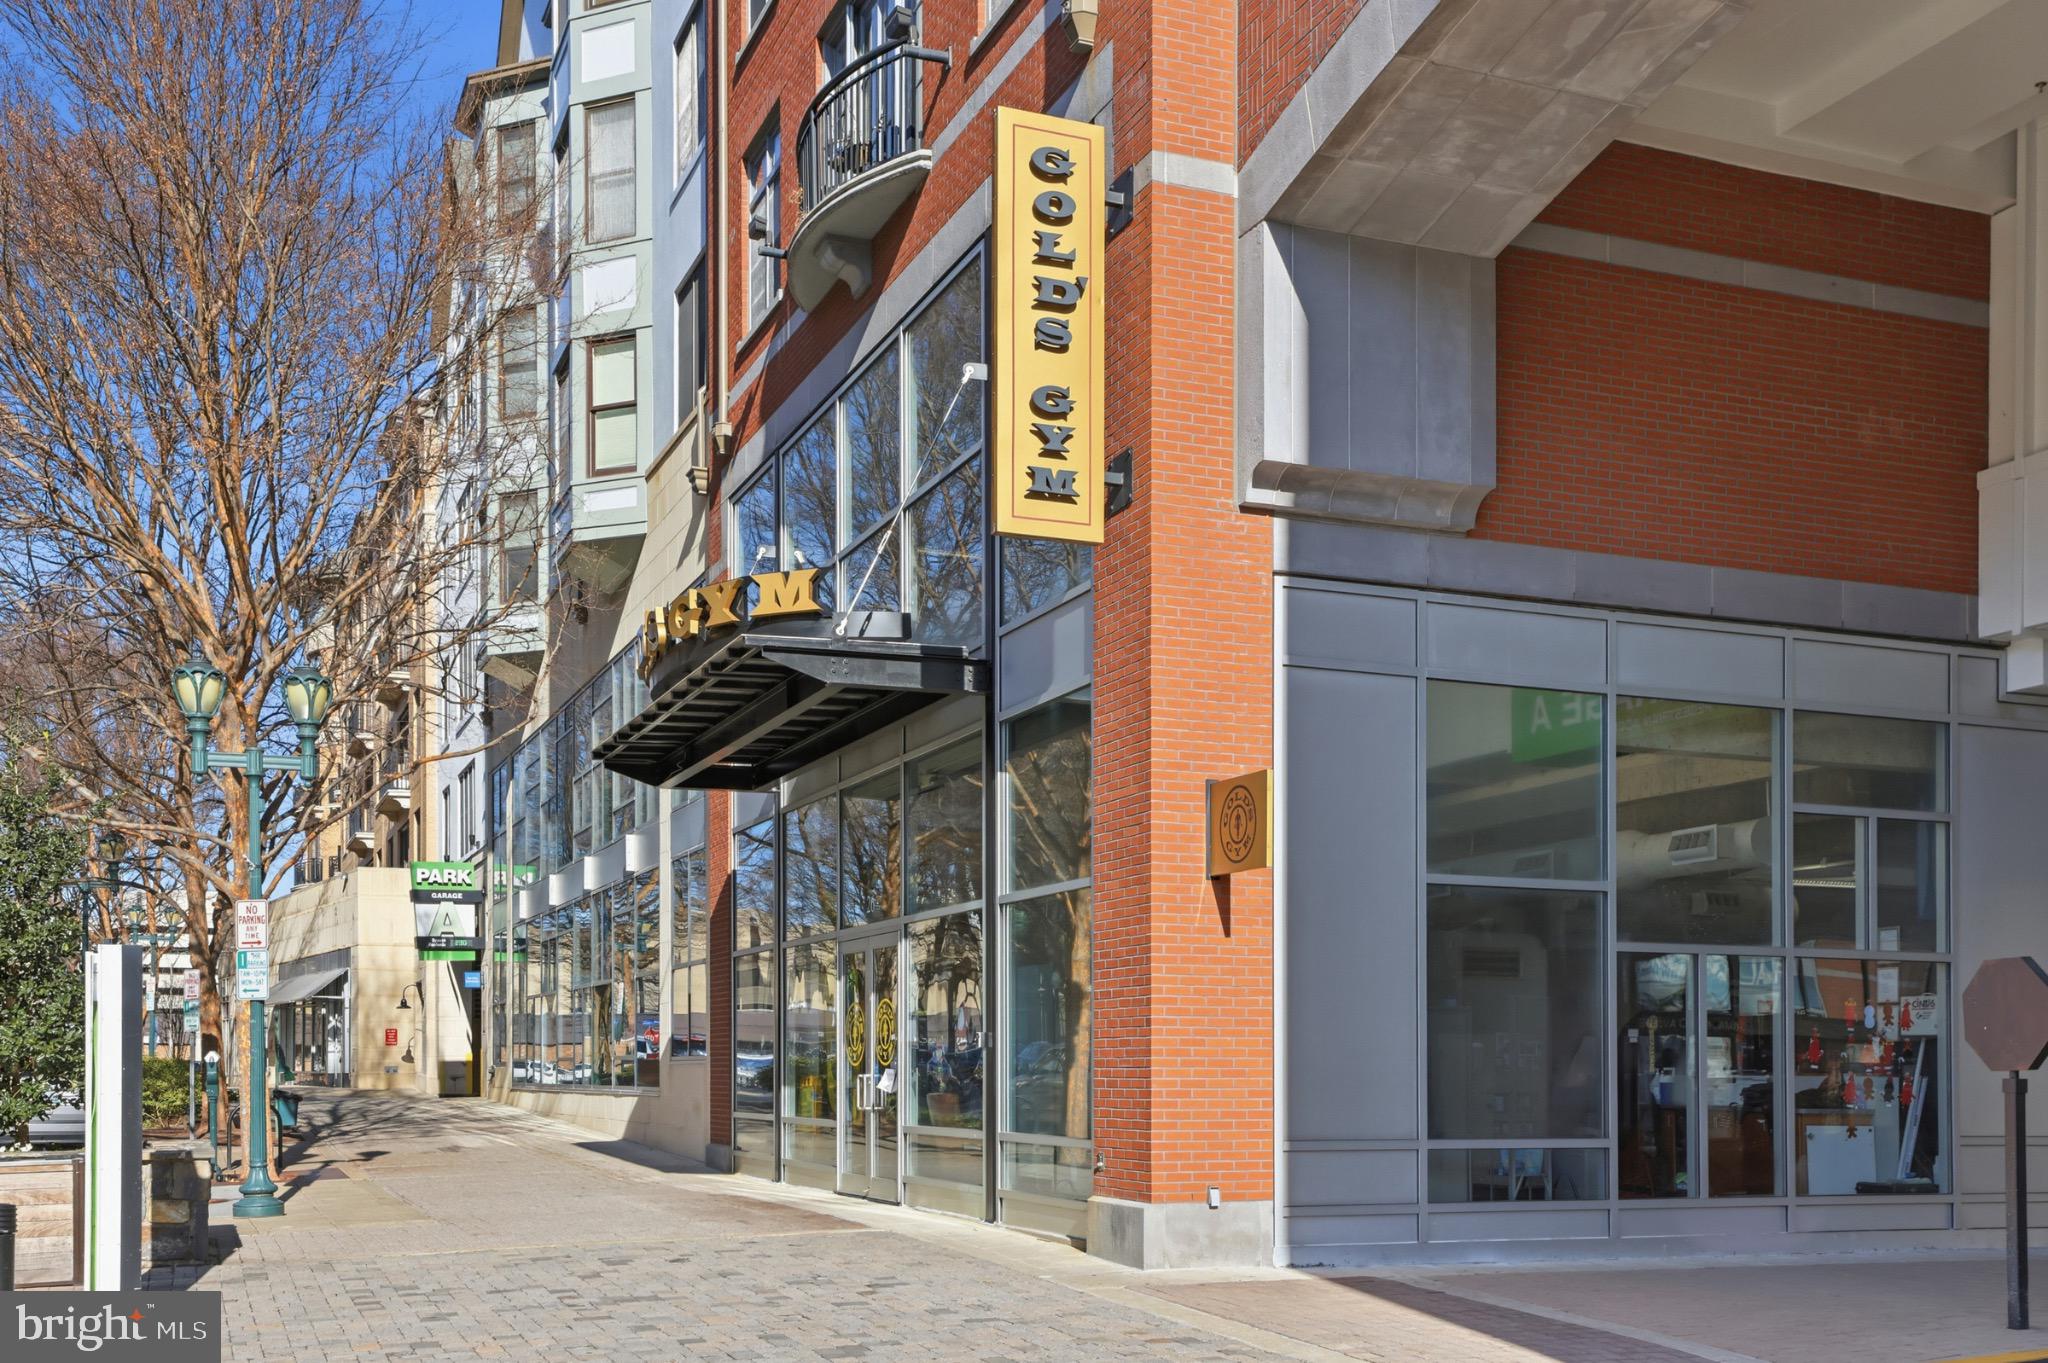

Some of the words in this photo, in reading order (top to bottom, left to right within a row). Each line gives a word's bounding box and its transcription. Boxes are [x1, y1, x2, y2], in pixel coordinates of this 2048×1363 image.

[1030, 146, 1089, 353] GOLD'S
[1025, 385, 1081, 505] GYM
[669, 568, 826, 638] GYM
[416, 868, 472, 886] PARK
[239, 915, 266, 924] PARKING
[246, 905, 258, 914] NO
[428, 901, 466, 937] A
[241, 953, 246, 967] 1
